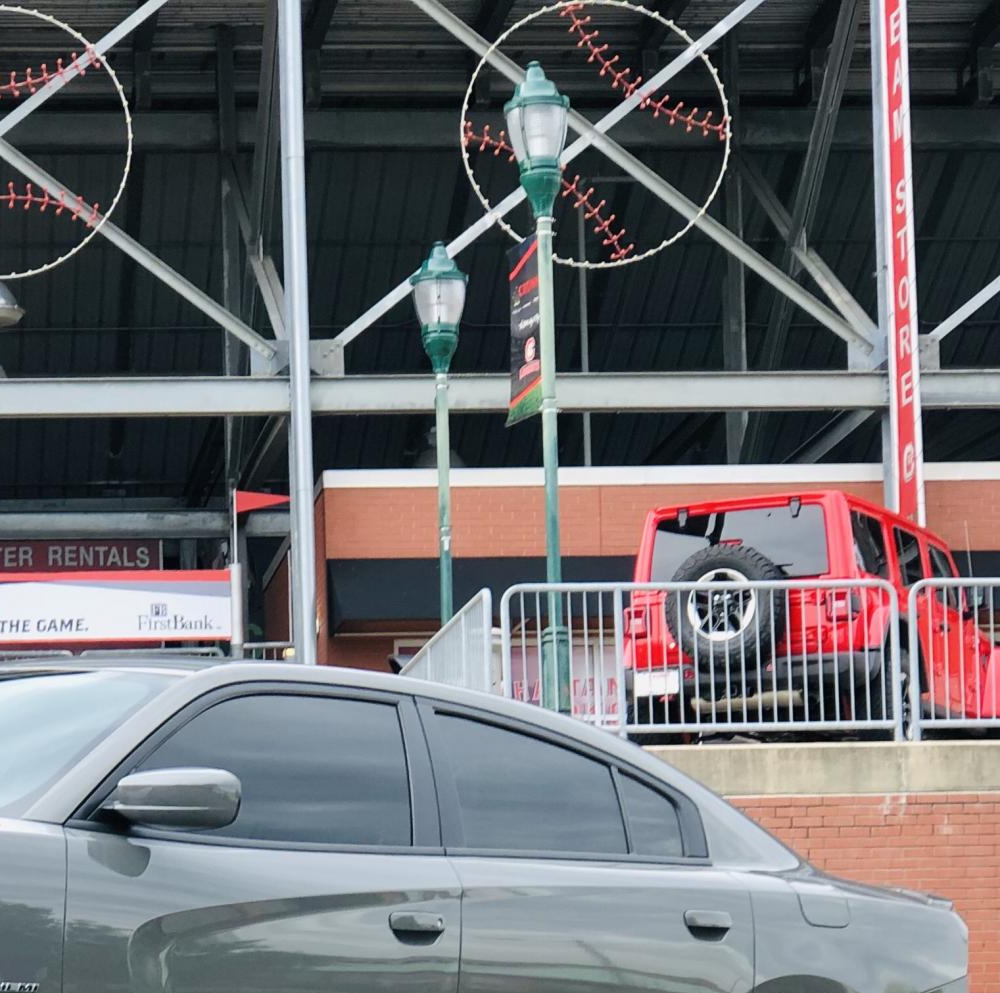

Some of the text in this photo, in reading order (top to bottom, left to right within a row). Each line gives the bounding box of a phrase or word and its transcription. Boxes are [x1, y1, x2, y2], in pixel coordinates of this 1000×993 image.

[896, 178, 914, 407] STORE
[48, 546, 150, 568] RENTALS
[36, 618, 90, 632] GAME.
[138, 613, 214, 632] FirstBank
